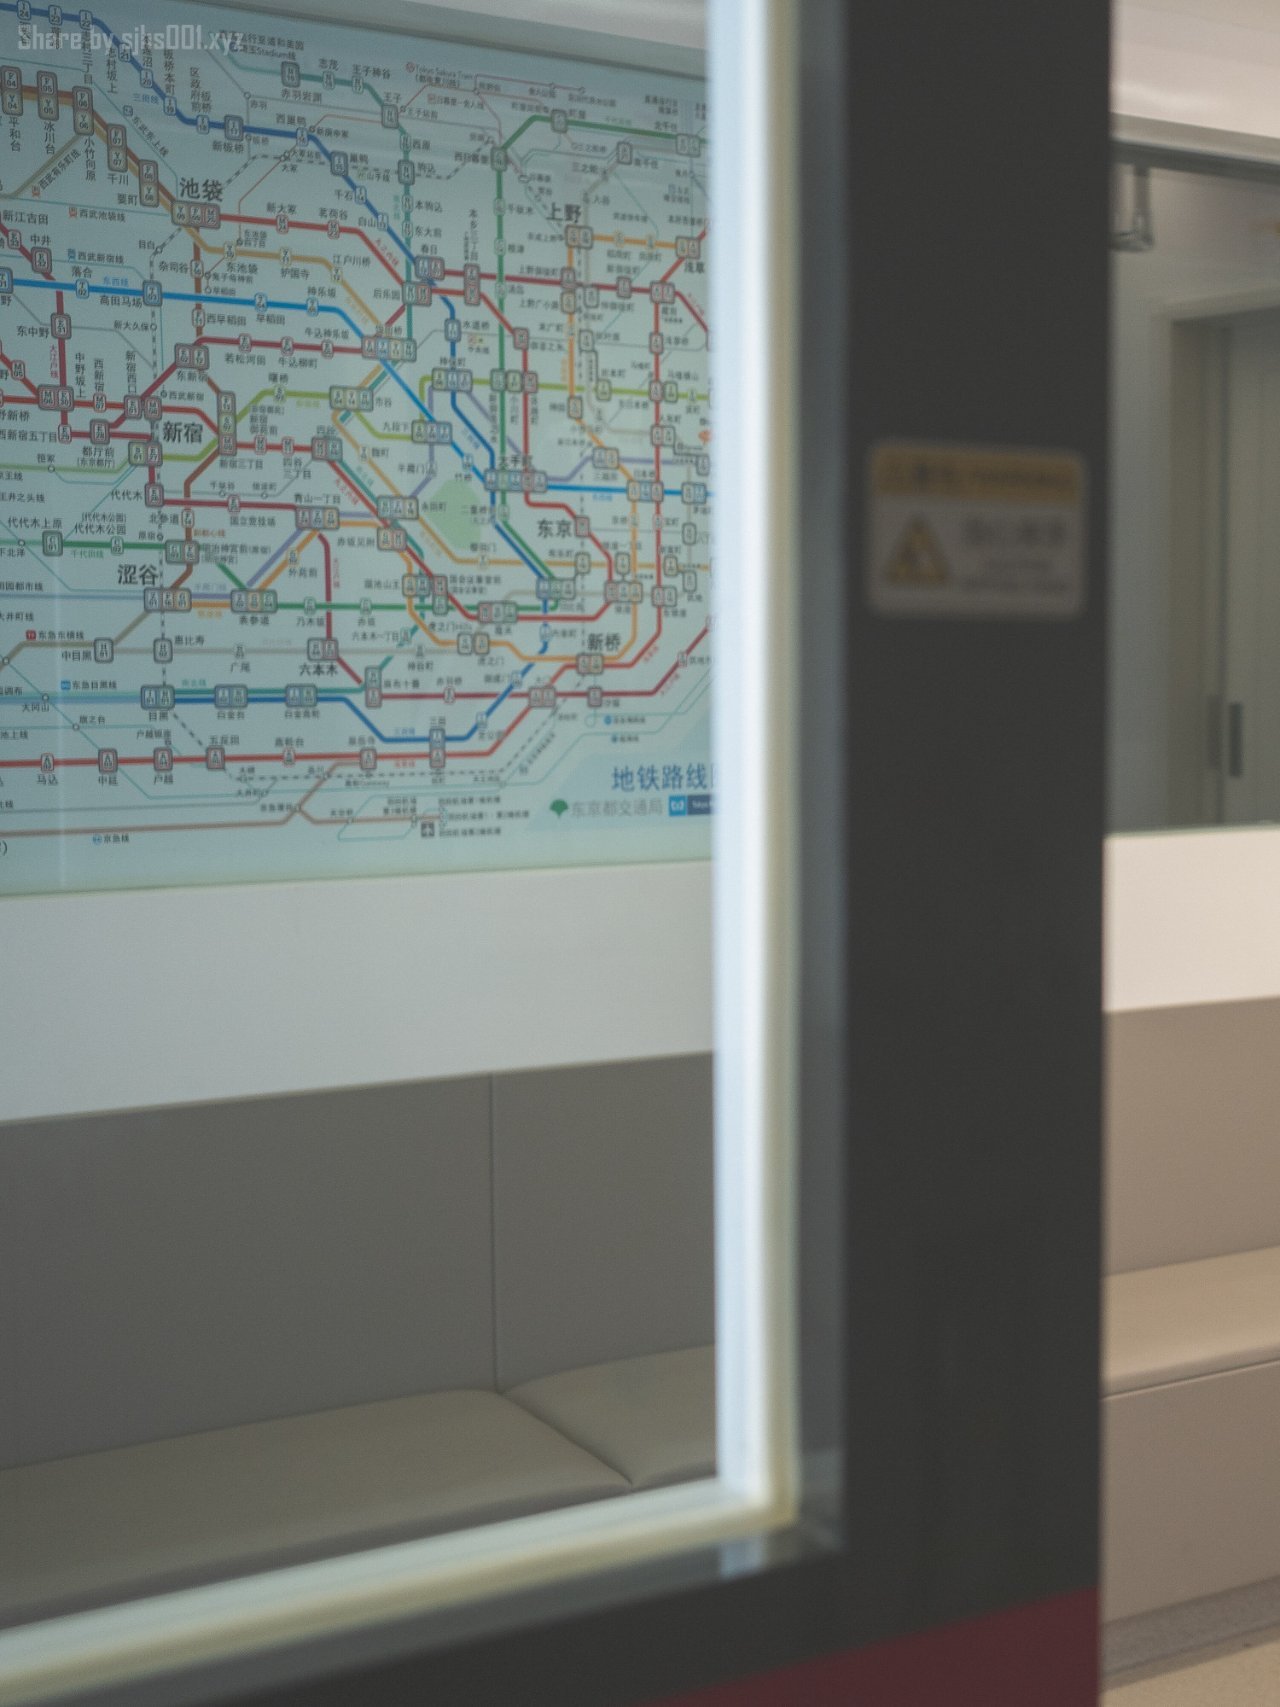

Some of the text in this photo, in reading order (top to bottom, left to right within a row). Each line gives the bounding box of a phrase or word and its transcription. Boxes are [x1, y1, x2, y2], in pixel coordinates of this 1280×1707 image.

[8, 117, 21, 153] 平和台
[43, 121, 56, 155] 冰川台
[84, 137, 97, 182] 小竹向原
[107, 173, 129, 186] 千川
[180, 177, 224, 202] 池袋
[30, 234, 51, 247] 中井
[71, 266, 93, 279] 落合
[17, 325, 50, 338] 东中野
[75, 351, 87, 399] 中野坂上
[162, 421, 203, 443] 新宿
[110, 490, 143, 501] 代代木
[8, 517, 63, 530] 代代木上原
[74, 523, 127, 536] 代代木公园
[537, 519, 573, 539] 东京
[117, 563, 159, 586] 涩谷
[61, 650, 93, 662] 中目黑
[299, 662, 339, 677] 六本木
[611, 762, 713, 791] 地铁路线
